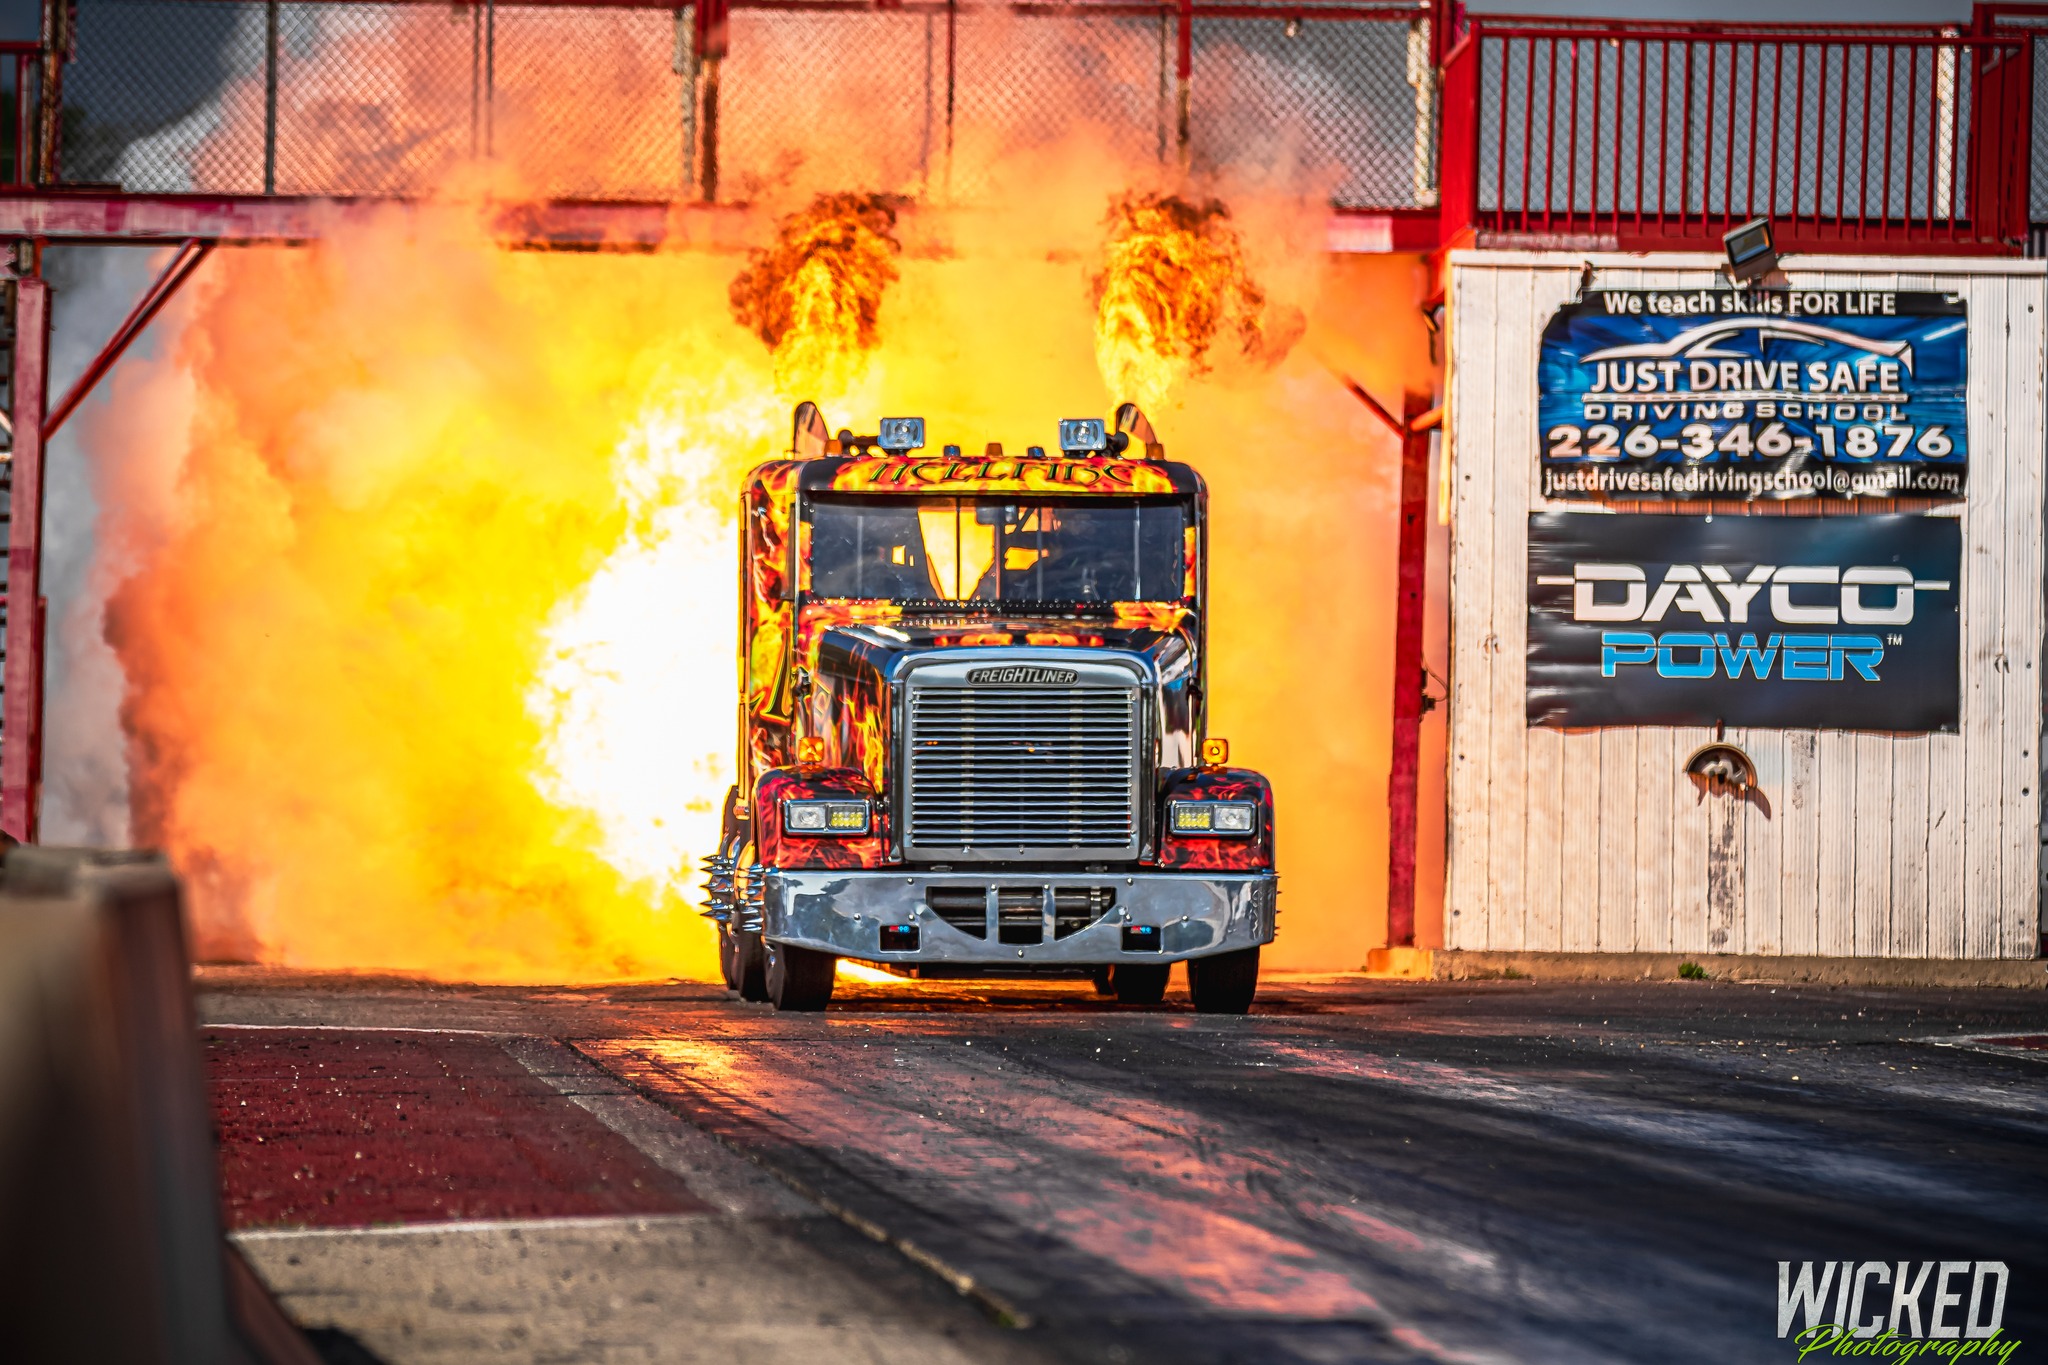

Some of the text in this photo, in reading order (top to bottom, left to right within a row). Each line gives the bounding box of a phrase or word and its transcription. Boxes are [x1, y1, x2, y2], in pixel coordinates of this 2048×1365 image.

[1603, 292, 1642, 314] We
[1648, 290, 1715, 314] teach
[1790, 292, 1839, 314] FOR
[1846, 292, 1896, 314] LIFE
[1590, 361, 1899, 392] JUST DRIVE SAFE
[1584, 402, 1907, 421] DRIVING SCHOOL
[1548, 423, 1953, 458] 226-346-1876
[1545, 465, 1960, 497] justdrivesafedrivingschool@gmail.com
[1573, 563, 1915, 625] DAYCO
[1601, 632, 1884, 681] POWER
[970, 668, 1075, 684] FREIGHTLINER
